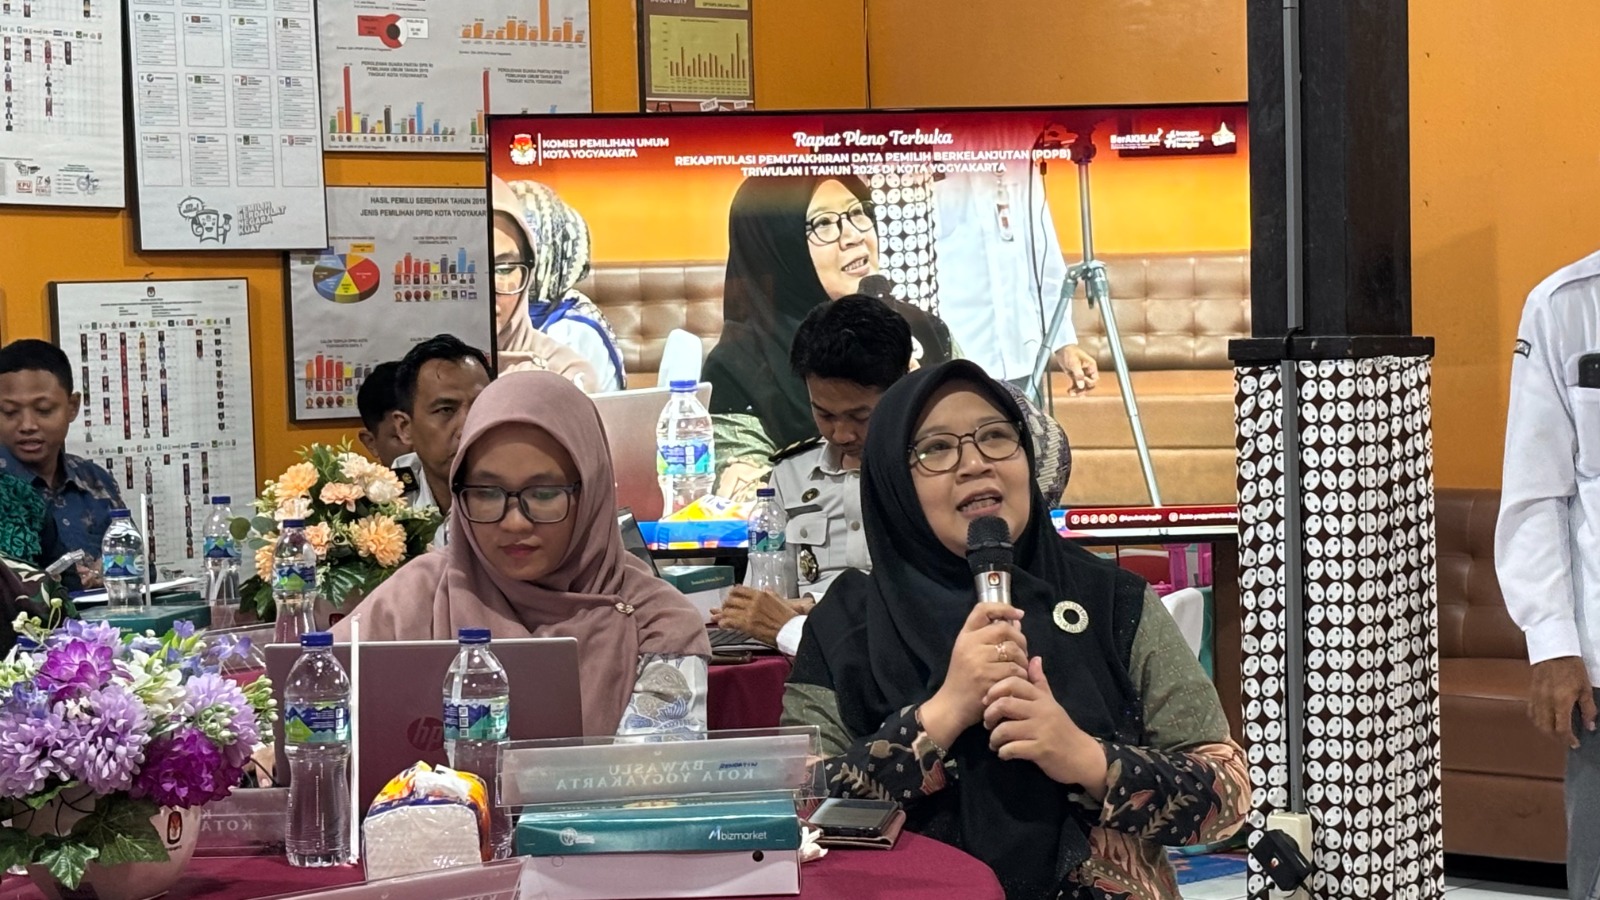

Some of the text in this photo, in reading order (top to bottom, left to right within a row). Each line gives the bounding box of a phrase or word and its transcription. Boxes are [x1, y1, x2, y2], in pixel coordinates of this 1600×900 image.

[542, 137, 669, 149] KOMISI PEMILIHAN UMUM
[792, 128, 954, 152] Rapat Pleno Terbuka
[542, 148, 638, 159] KOTA YOGYAKARTA
[674, 149, 1071, 166] REKAPITULASI PEMUTAKHIRAN DATA PEMILIH BERKELANJUTAN (PDPB)
[740, 162, 1007, 177] TRIWULAN I TAHUN 2026 DI KOTA YOGYAKARTA
[390, 197, 414, 205] PEMILU
[415, 197, 449, 205] SERENTAK
[360, 209, 379, 217] JENIS
[434, 209, 452, 217] KOTA
[452, 209, 487, 217] YOGYAKAR
[412, 716, 444, 750] hp
